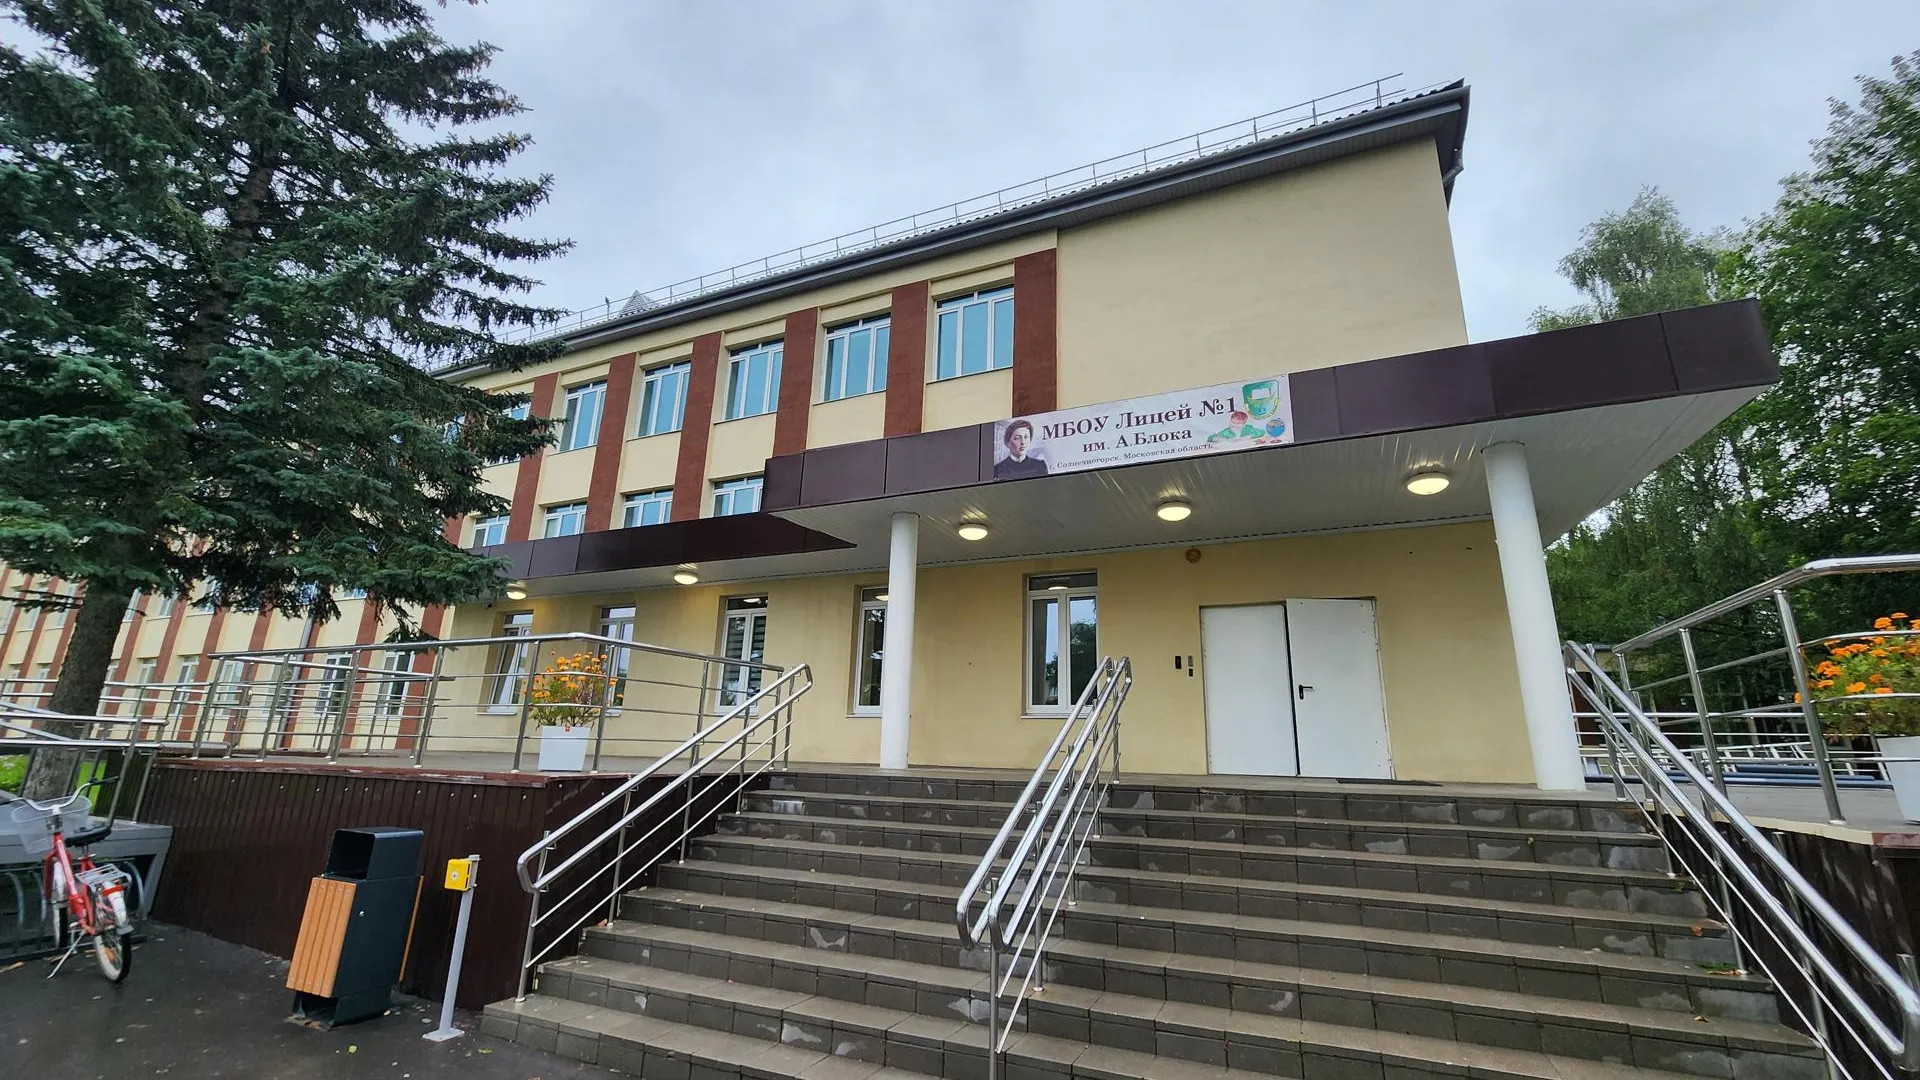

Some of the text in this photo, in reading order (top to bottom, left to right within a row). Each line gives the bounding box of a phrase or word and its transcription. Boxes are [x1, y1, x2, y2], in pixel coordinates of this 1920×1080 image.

[1042, 415, 1109, 440] МБОУ
[1116, 404, 1192, 429] Лицей
[1199, 397, 1237, 417] №1
[1082, 429, 1192, 452] им. А.Блока
[1124, 448, 1175, 460] Московская
